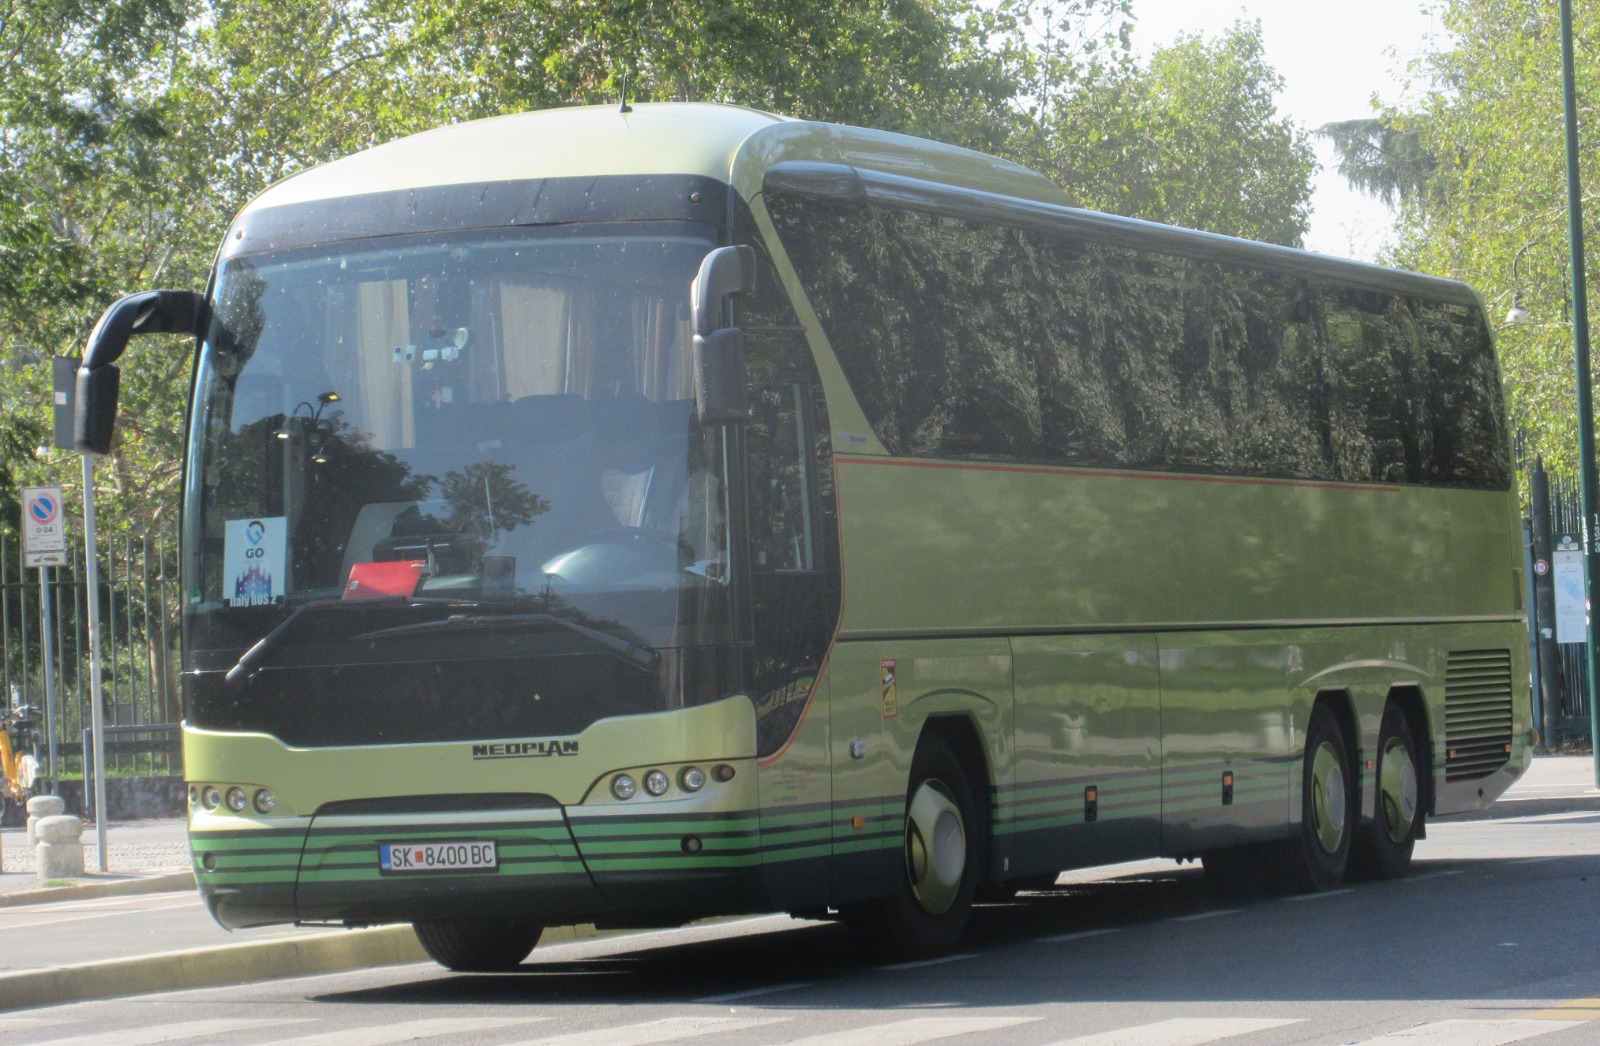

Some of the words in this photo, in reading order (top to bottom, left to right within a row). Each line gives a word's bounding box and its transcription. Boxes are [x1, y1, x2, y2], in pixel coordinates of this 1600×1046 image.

[245, 547, 265, 559] GO
[250, 593, 269, 606] BUS
[270, 594, 277, 605] 2
[472, 740, 579, 757] NEOPLAN
[391, 846, 413, 868] SK
[425, 845, 467, 867] 8400
[471, 844, 493, 865] BC
